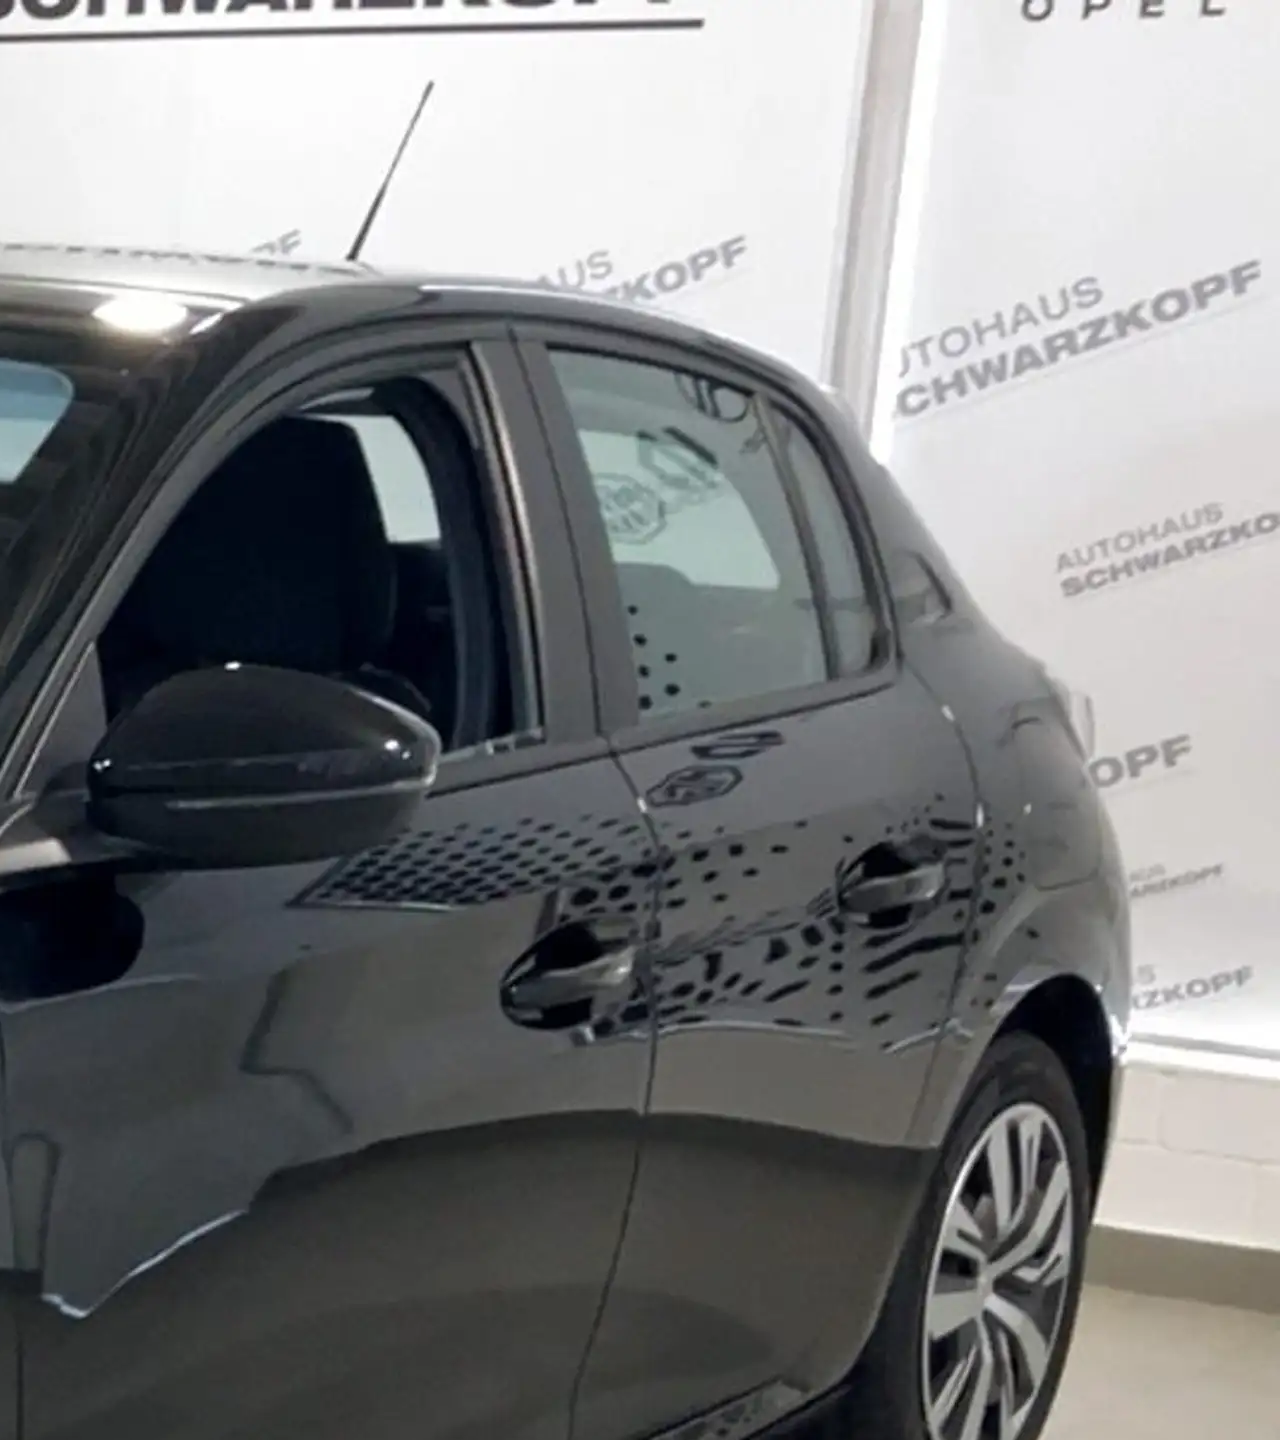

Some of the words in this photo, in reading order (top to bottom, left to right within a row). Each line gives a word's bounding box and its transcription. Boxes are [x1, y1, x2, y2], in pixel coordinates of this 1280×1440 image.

[896, 260, 1262, 417] CHWARZKOPF
[1056, 502, 1223, 573] AUTOHAUS
[1059, 511, 1280, 598] SCHWARZKO
